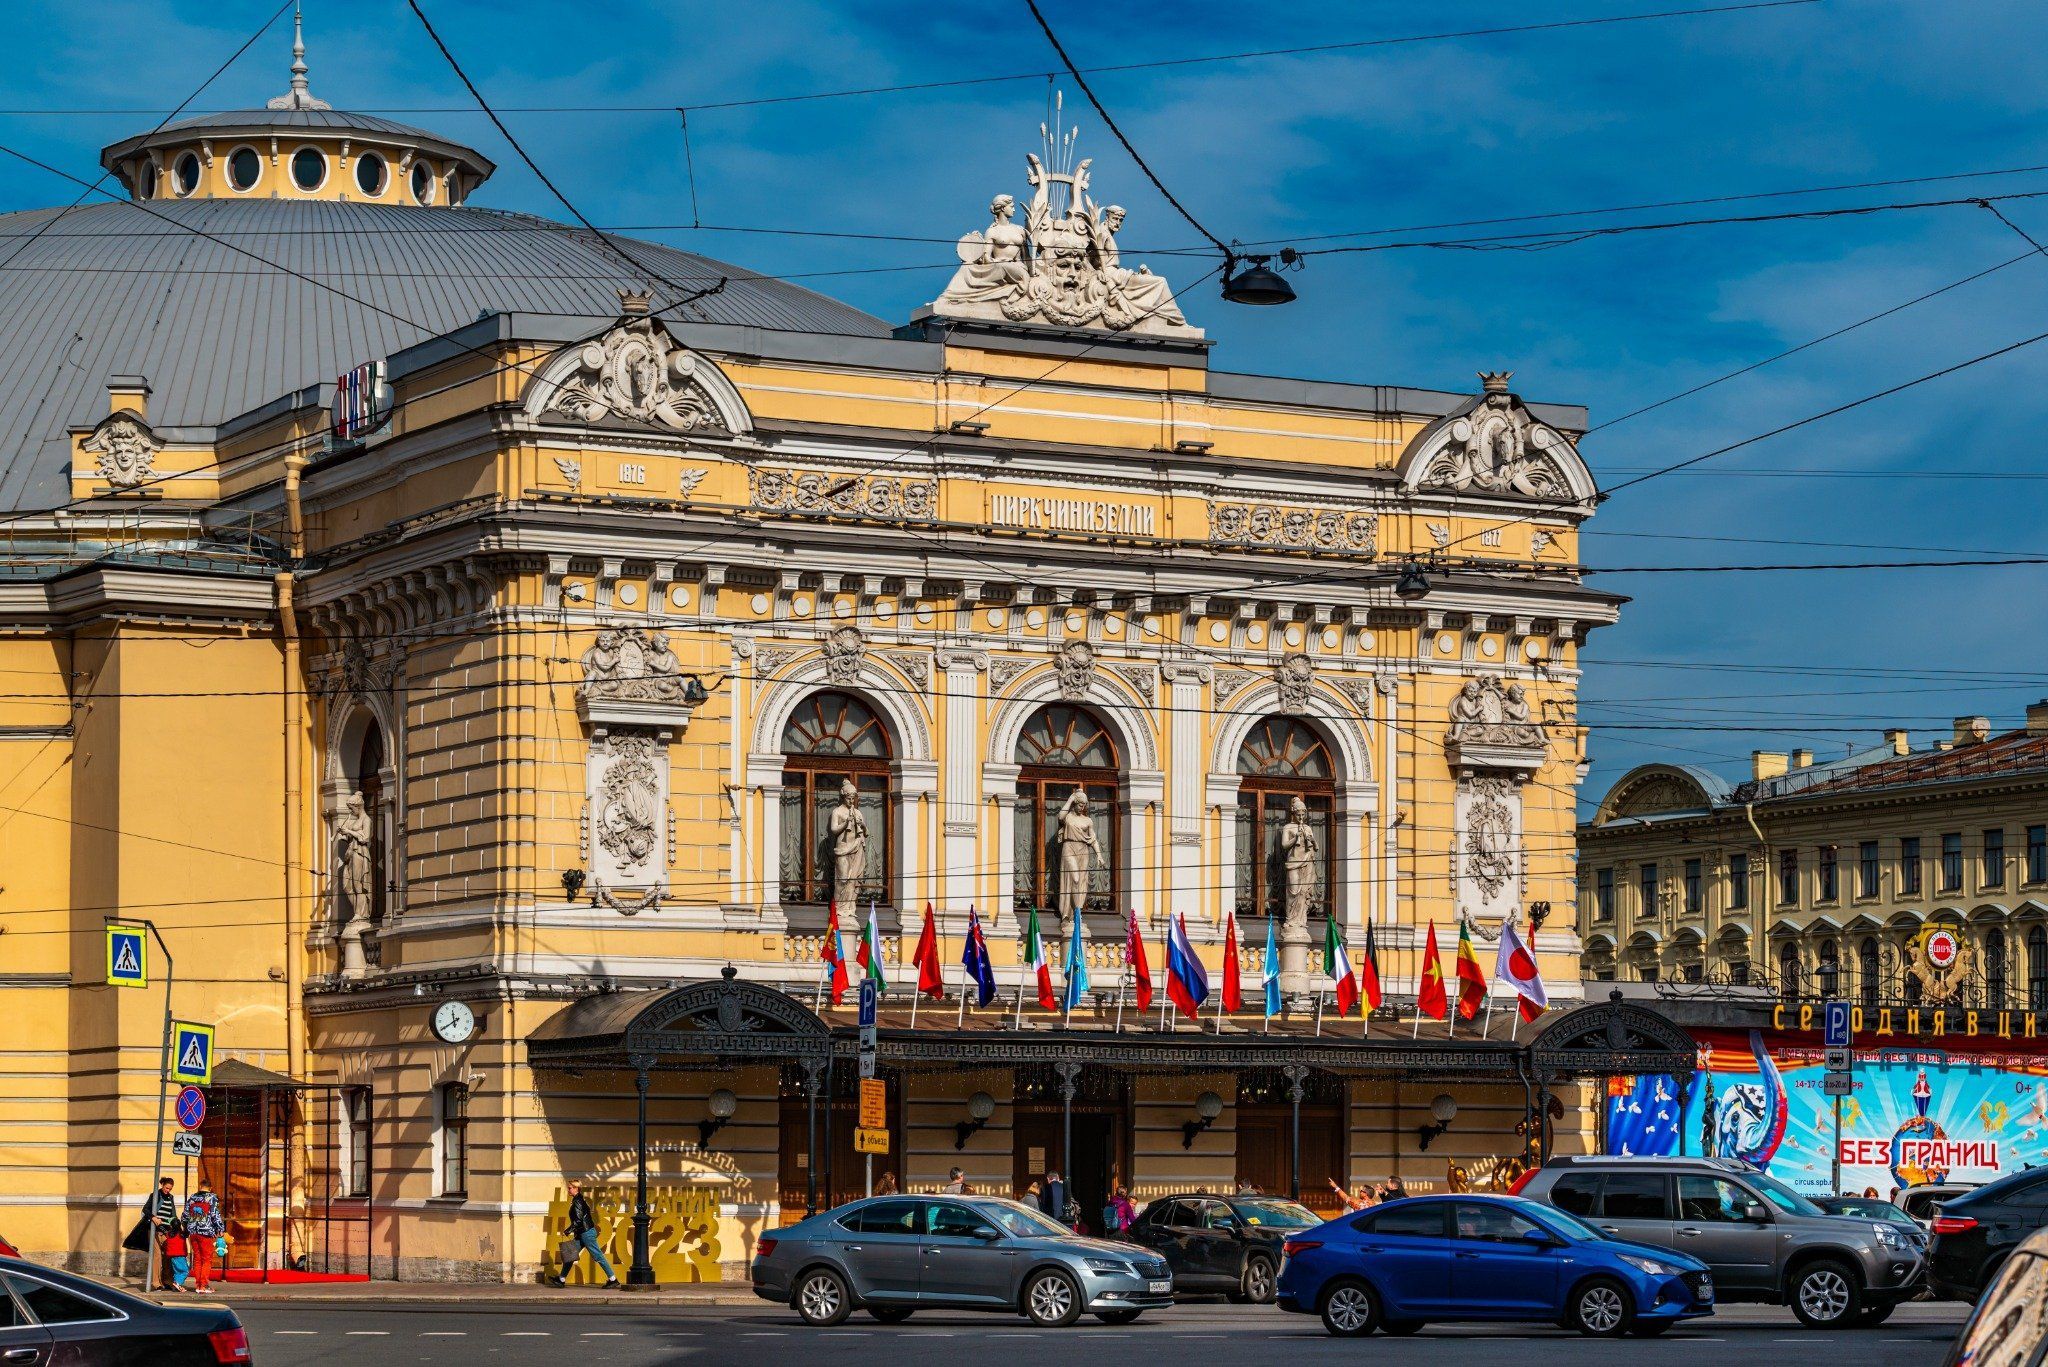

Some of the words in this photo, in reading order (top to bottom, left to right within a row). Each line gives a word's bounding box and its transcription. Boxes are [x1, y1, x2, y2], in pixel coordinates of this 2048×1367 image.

[618, 463, 645, 484] 1876
[991, 494, 1042, 528] ЦИРК
[1042, 498, 1155, 536] ЧИНИЗЕЛЛИ
[1480, 527, 1502, 547] 1877
[1774, 1004, 1945, 1036] СЕОДНЯ
[1883, 1051, 1942, 1065] ФЕСТИВАЛЬ
[1945, 1053, 2004, 1066] ЦИРКОВОГО
[1795, 1080, 1815, 1088] 14-17
[2015, 1081, 2032, 1094] 0+
[1840, 1140, 1890, 1164] БЕЗ
[1902, 1142, 1999, 1171] ГРАНИЦ
[1794, 1178, 1832, 1188] circus.spb.r
